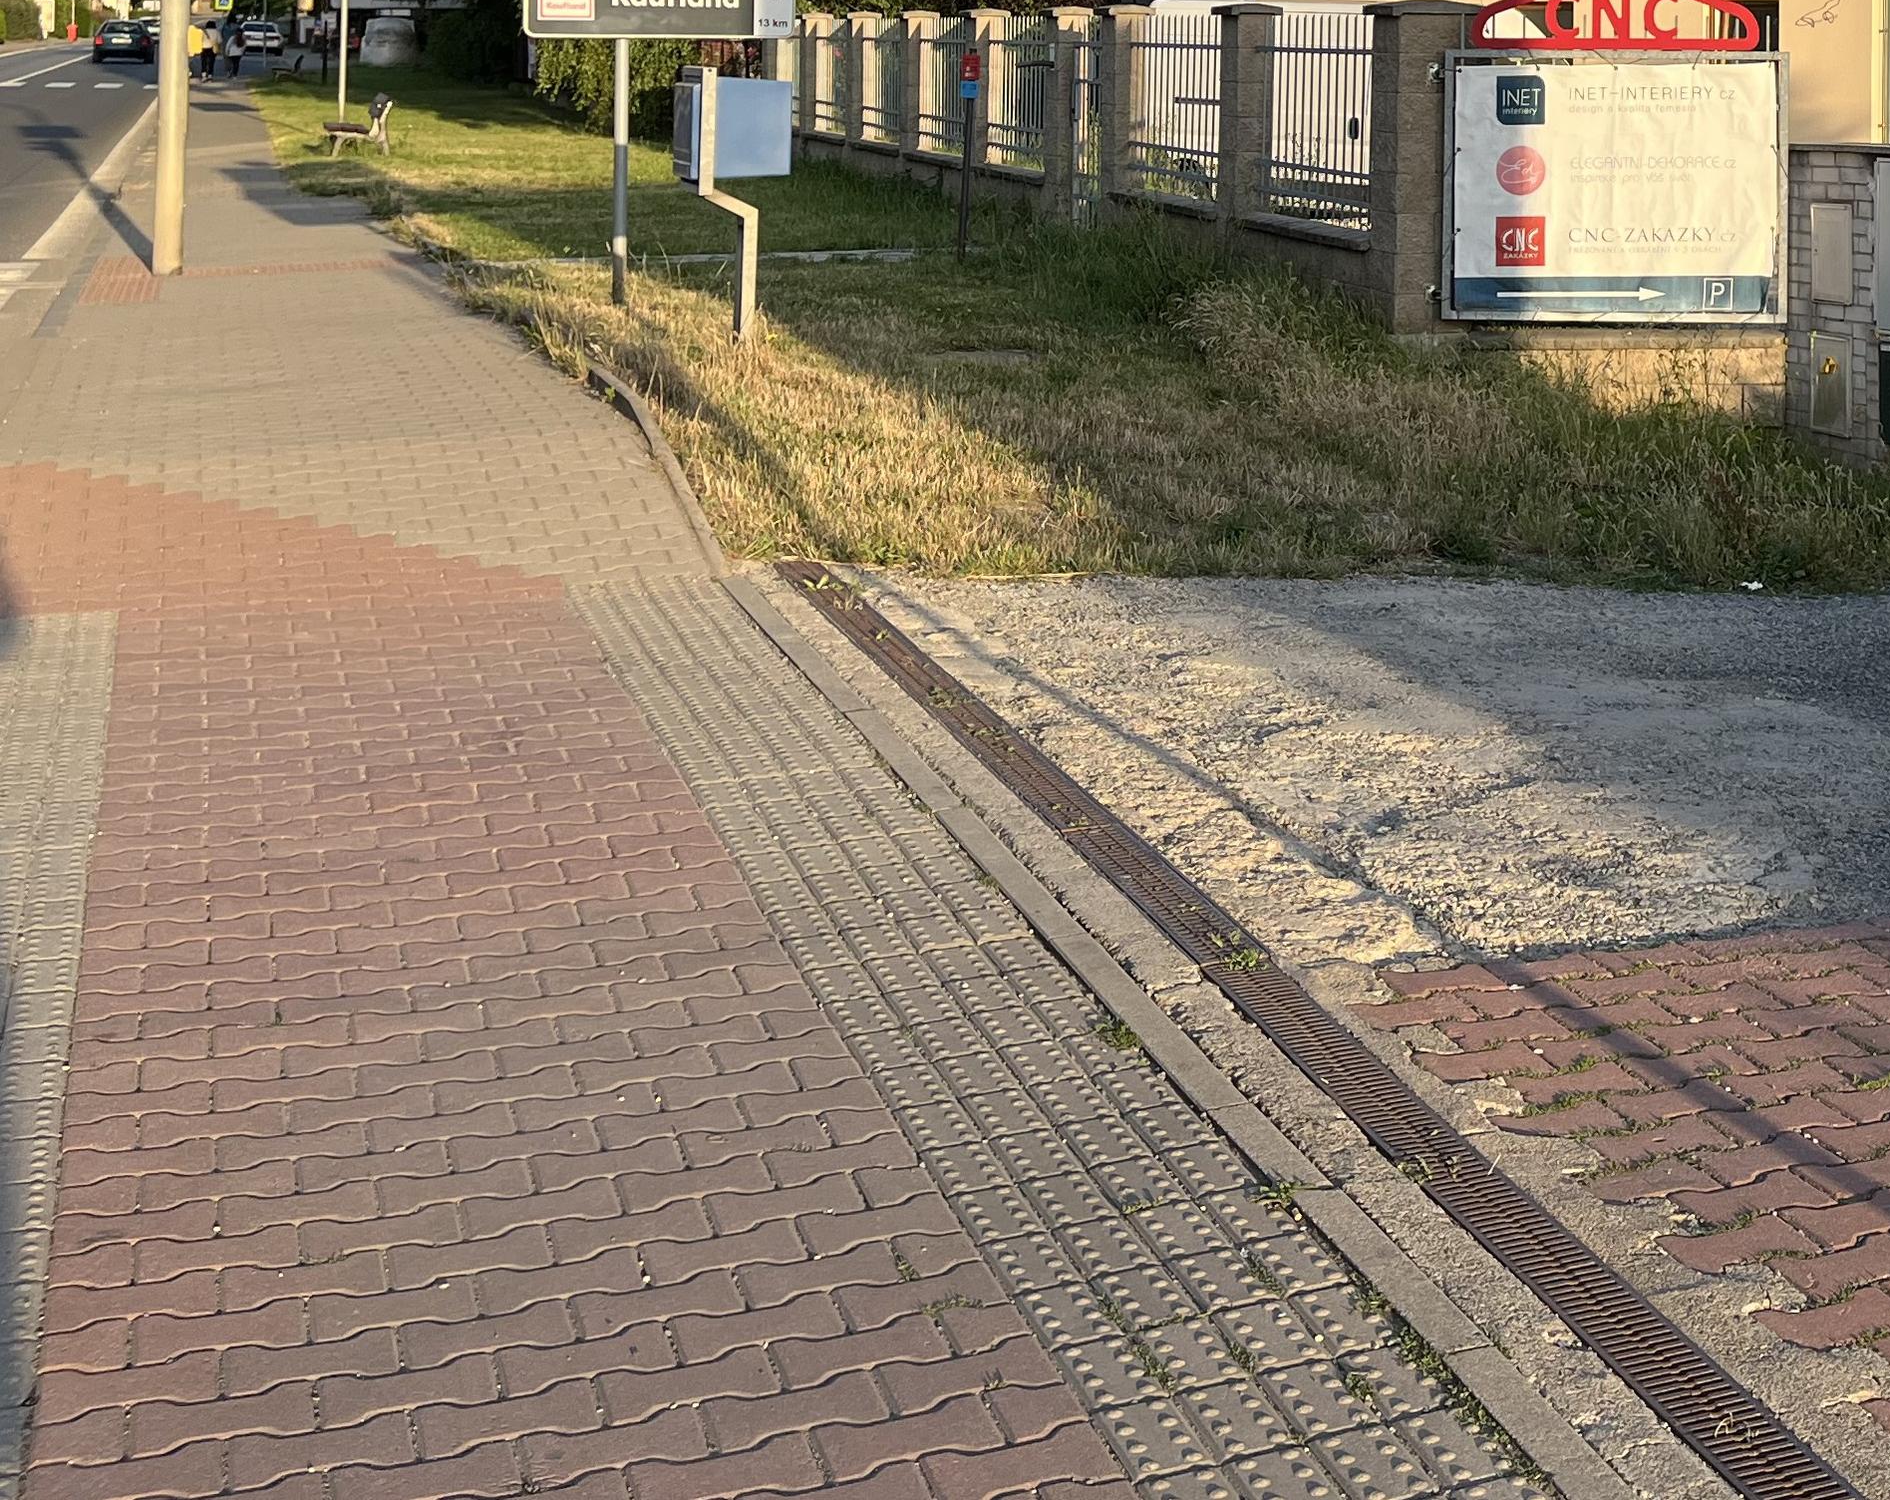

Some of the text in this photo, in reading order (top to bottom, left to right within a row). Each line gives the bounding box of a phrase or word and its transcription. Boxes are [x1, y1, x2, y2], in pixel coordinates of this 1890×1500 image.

[772, 18, 788, 28] km
[1502, 88, 1541, 107] INET
[1569, 86, 1714, 100] INET-INTERIERY
[1502, 228, 1539, 251] CNC
[1710, 282, 1725, 306] P
